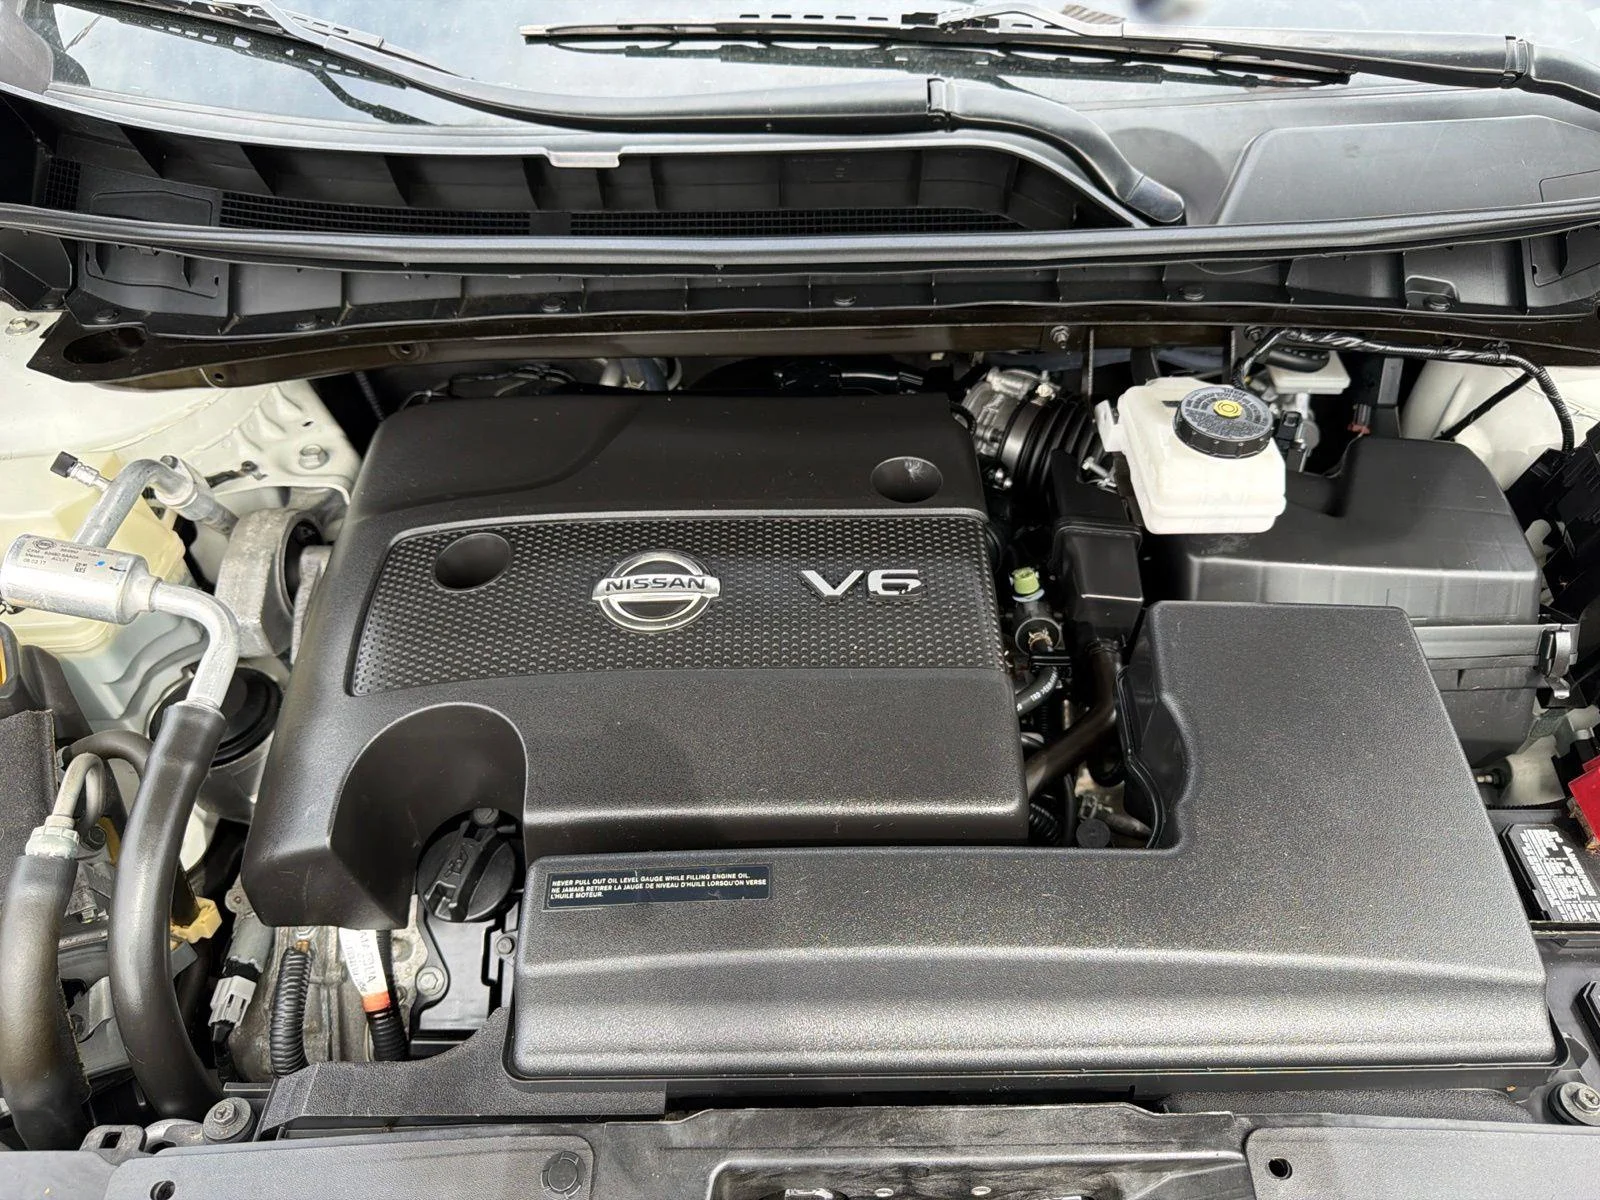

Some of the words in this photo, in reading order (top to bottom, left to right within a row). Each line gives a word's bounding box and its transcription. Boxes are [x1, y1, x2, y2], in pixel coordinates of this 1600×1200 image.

[605, 578, 706, 592] NISSAN
[800, 569, 922, 599] V6
[561, 885, 584, 893] JAMAIS
[586, 884, 612, 892] RETIRER
[623, 882, 643, 890] JAUGE
[680, 880, 706, 888] D'HUILE
[707, 879, 744, 887] LORSQU'ON
[745, 878, 767, 886] VERSE
[620, 876, 639, 884] LEVEL
[640, 875, 663, 883] GAUGE
[575, 891, 603, 899] MOTEUR.
